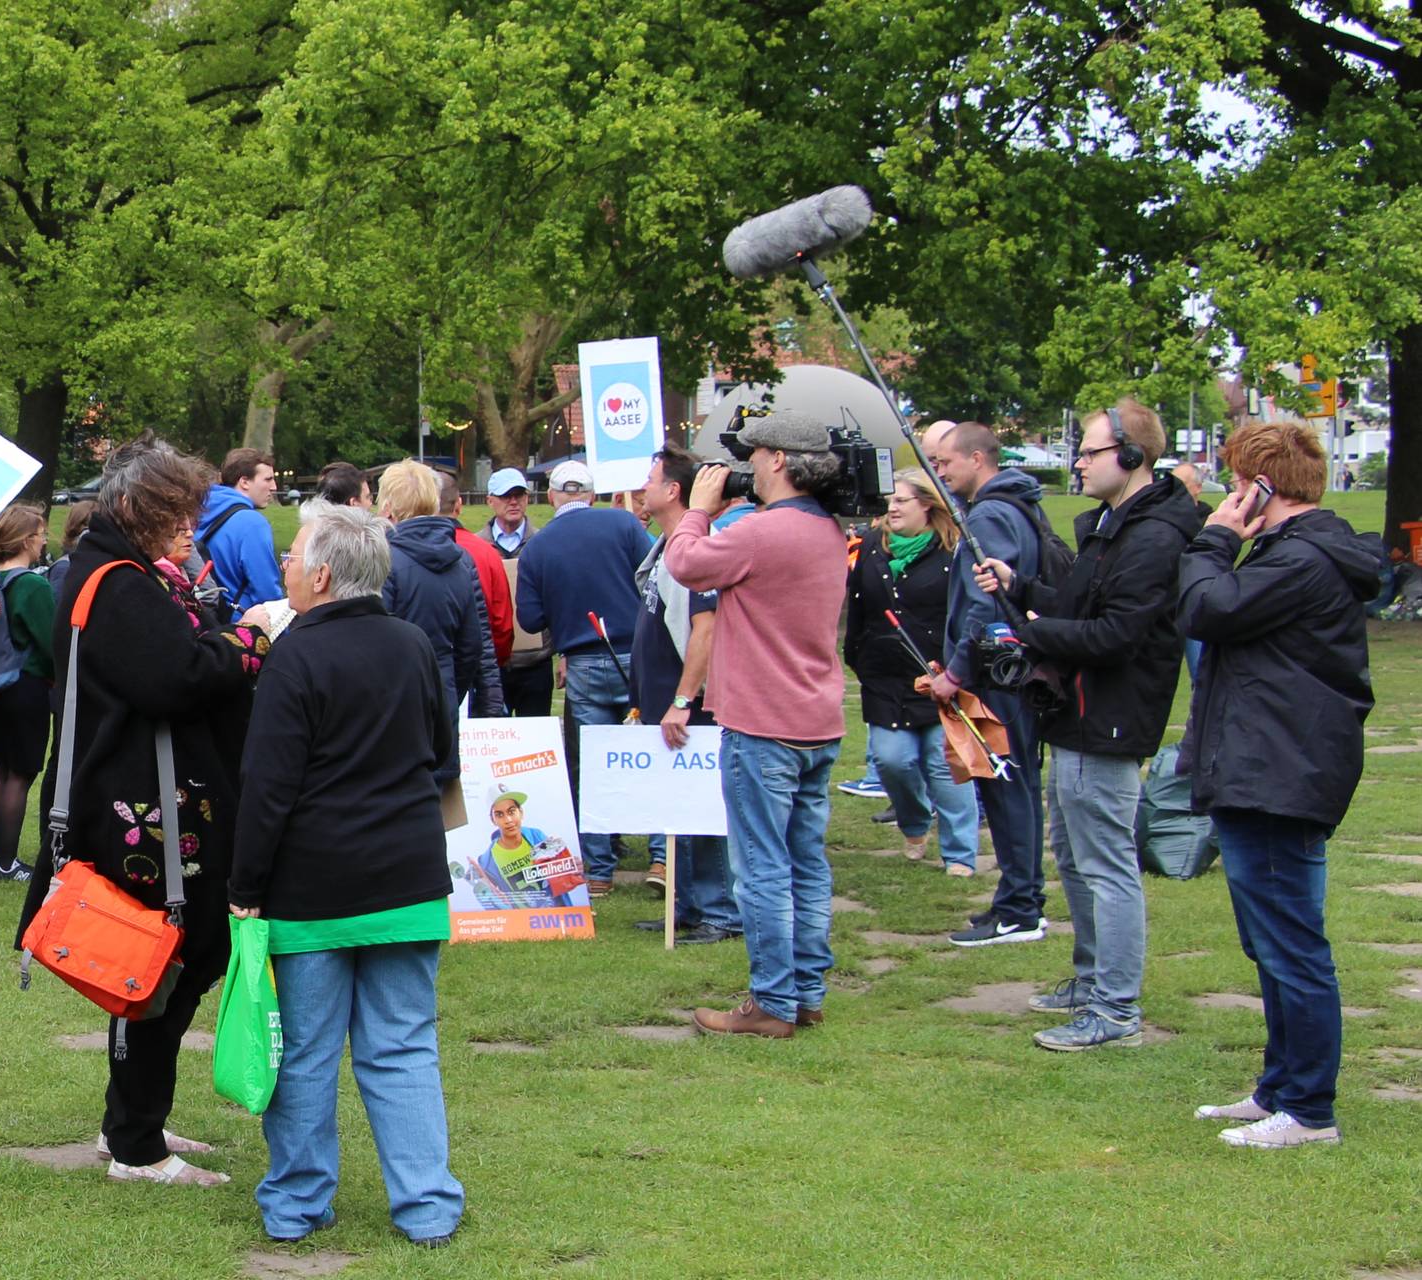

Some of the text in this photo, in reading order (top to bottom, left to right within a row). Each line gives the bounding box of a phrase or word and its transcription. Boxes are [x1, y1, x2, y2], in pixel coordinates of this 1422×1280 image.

[623, 398, 641, 411] MY
[604, 413, 642, 426] AASEE
[473, 727, 488, 740] im
[490, 727, 521, 741] Park,
[466, 744, 478, 757] in
[480, 743, 499, 757] die
[492, 751, 557, 777] Ich mach's.
[606, 752, 721, 770] PRO AAS
[526, 858, 575, 880] Lokalheld.
